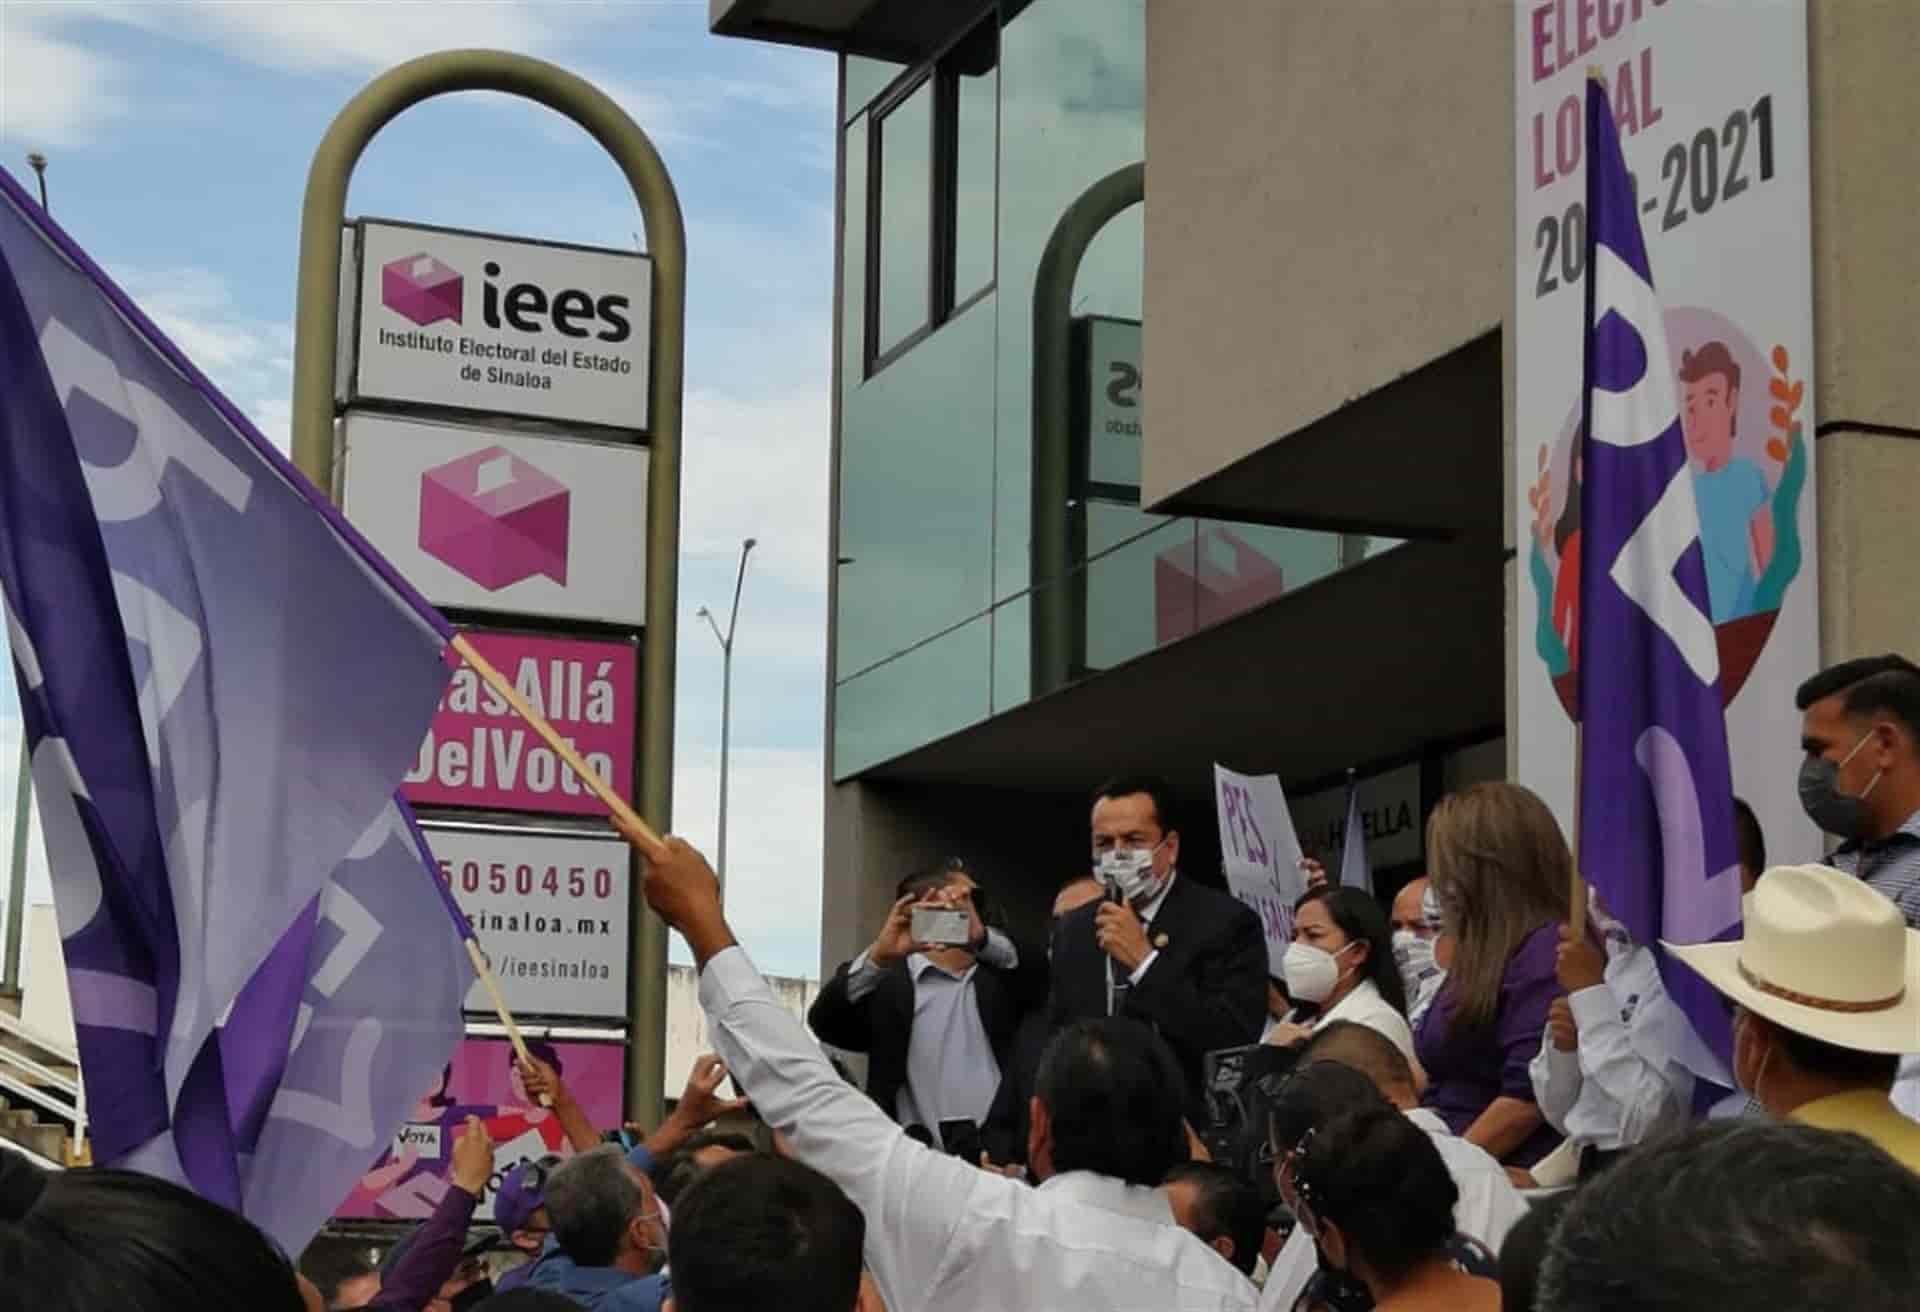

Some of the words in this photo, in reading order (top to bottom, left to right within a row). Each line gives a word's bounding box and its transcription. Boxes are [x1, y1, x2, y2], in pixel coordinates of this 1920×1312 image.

[1533, 46, 1663, 191] LOAL
[1535, 93, 1774, 300] 20-2021
[482, 261, 631, 343] iees
[379, 328, 453, 353] Instituto
[459, 338, 536, 363] Electoral
[542, 347, 567, 367] del
[573, 351, 631, 375] Estado
[460, 363, 481, 382] de
[487, 366, 551, 390] Sinaloa
[439, 656, 614, 724] ásAllá
